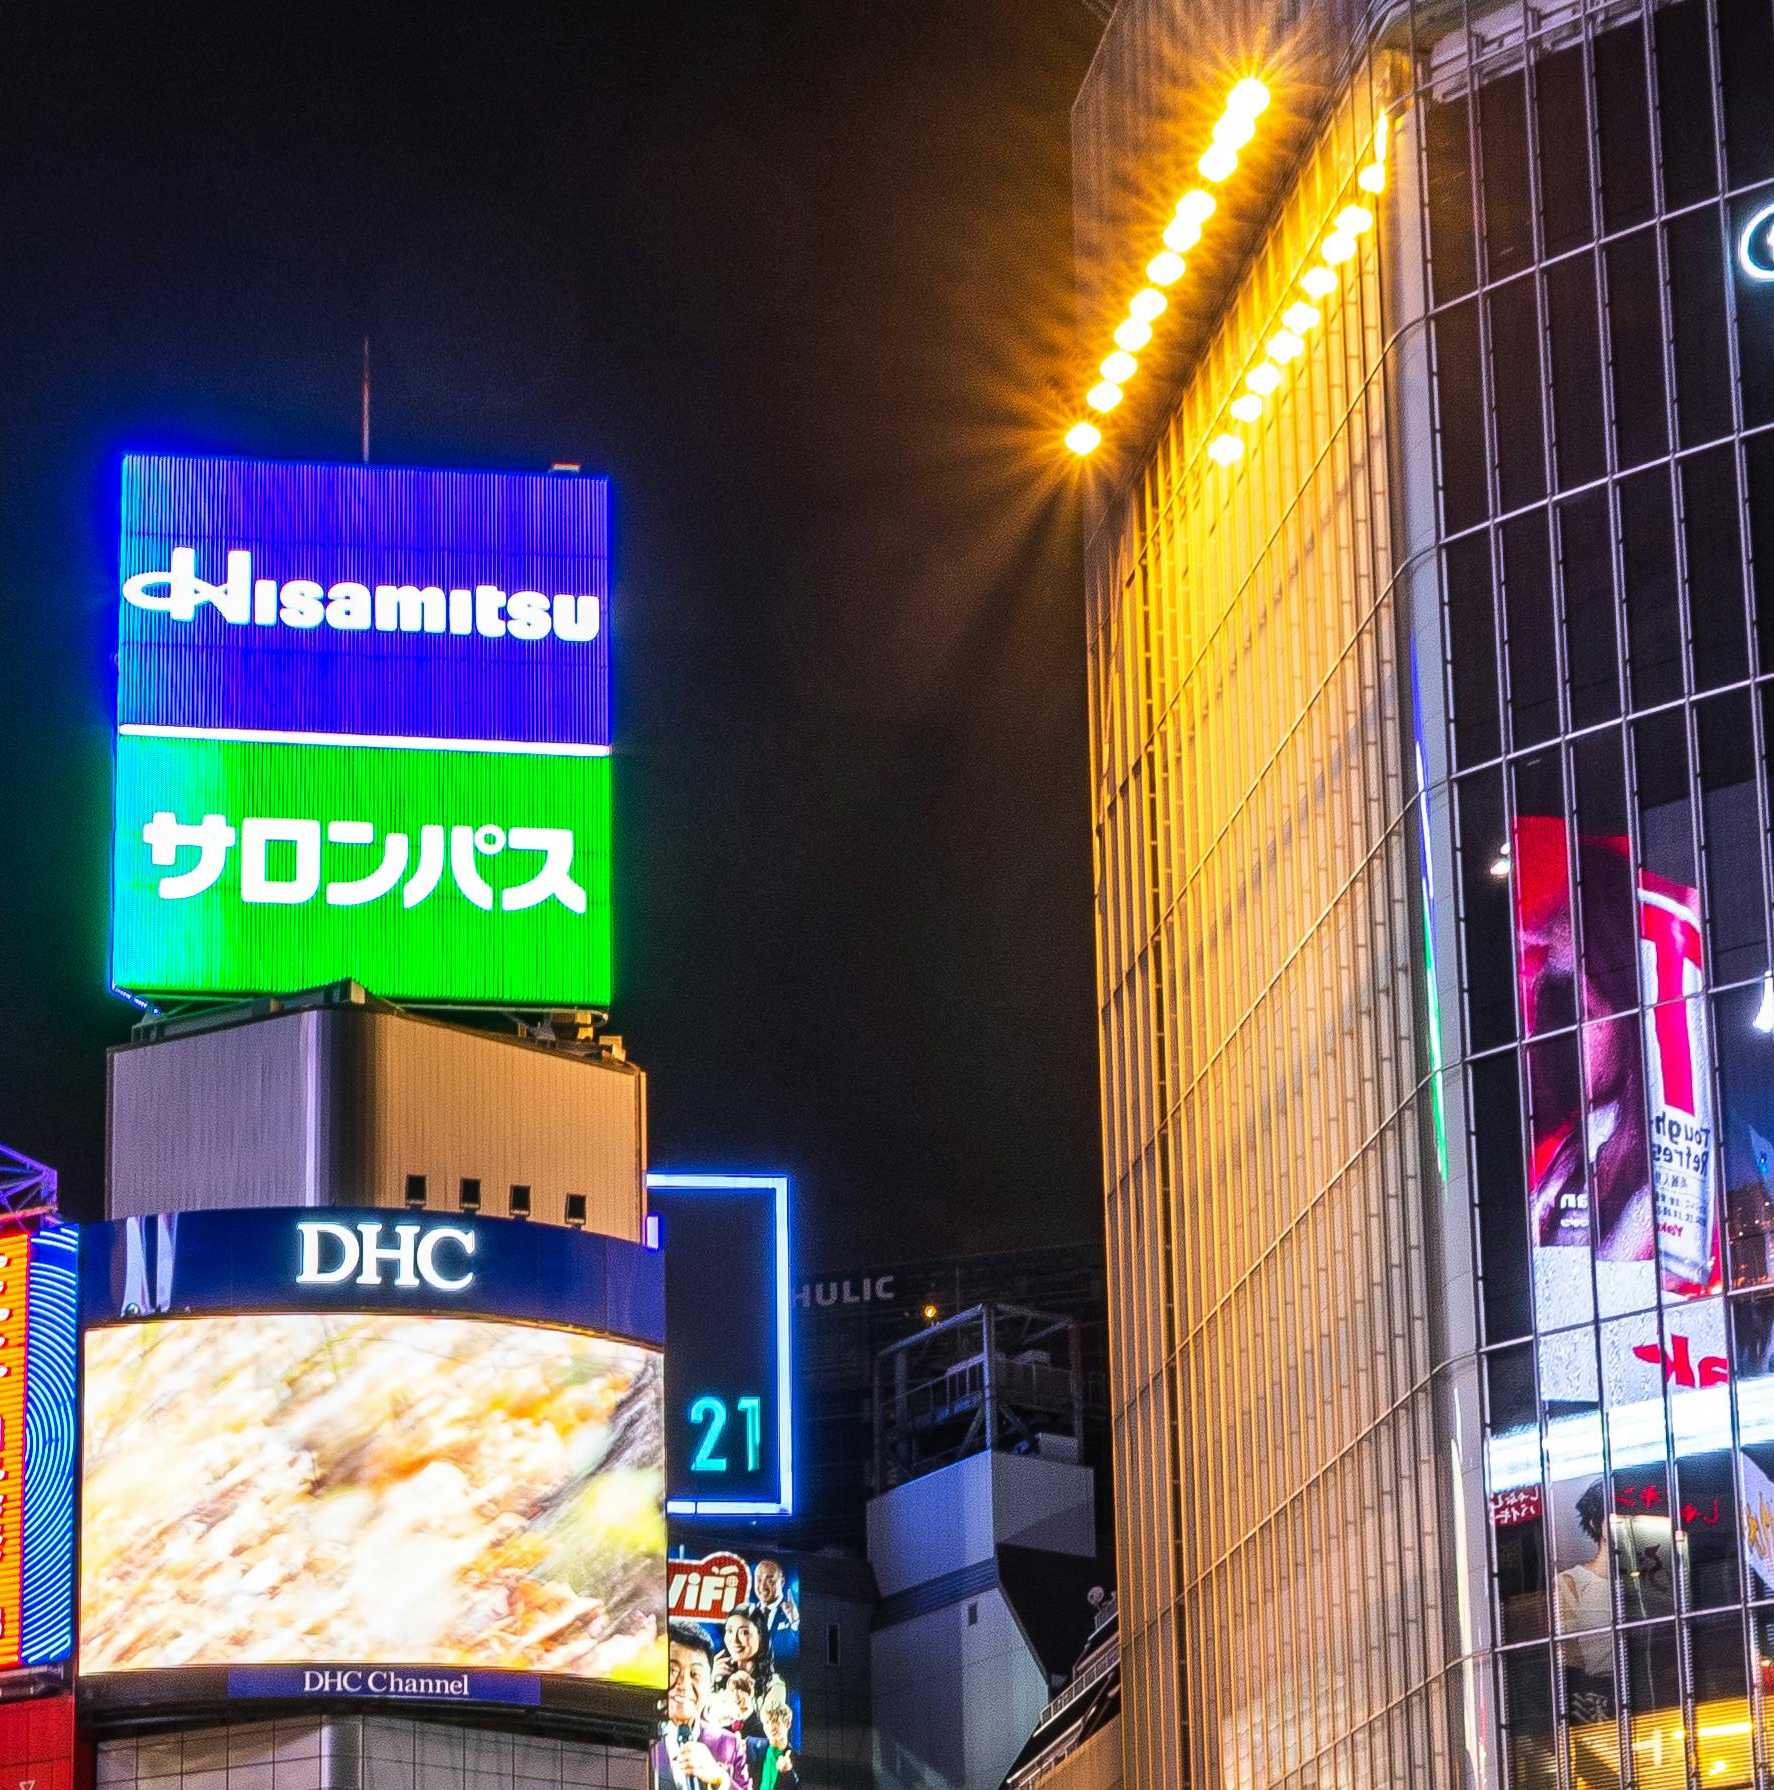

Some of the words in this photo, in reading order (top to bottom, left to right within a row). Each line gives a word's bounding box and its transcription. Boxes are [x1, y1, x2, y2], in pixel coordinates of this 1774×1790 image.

[122, 546, 600, 642] Hisamitsu
[143, 811, 587, 915] サロンパス
[296, 1221, 476, 1292] DHC
[689, 1395, 762, 1473] 21
[303, 1670, 363, 1695] DHC
[366, 1671, 471, 1697] Channel
